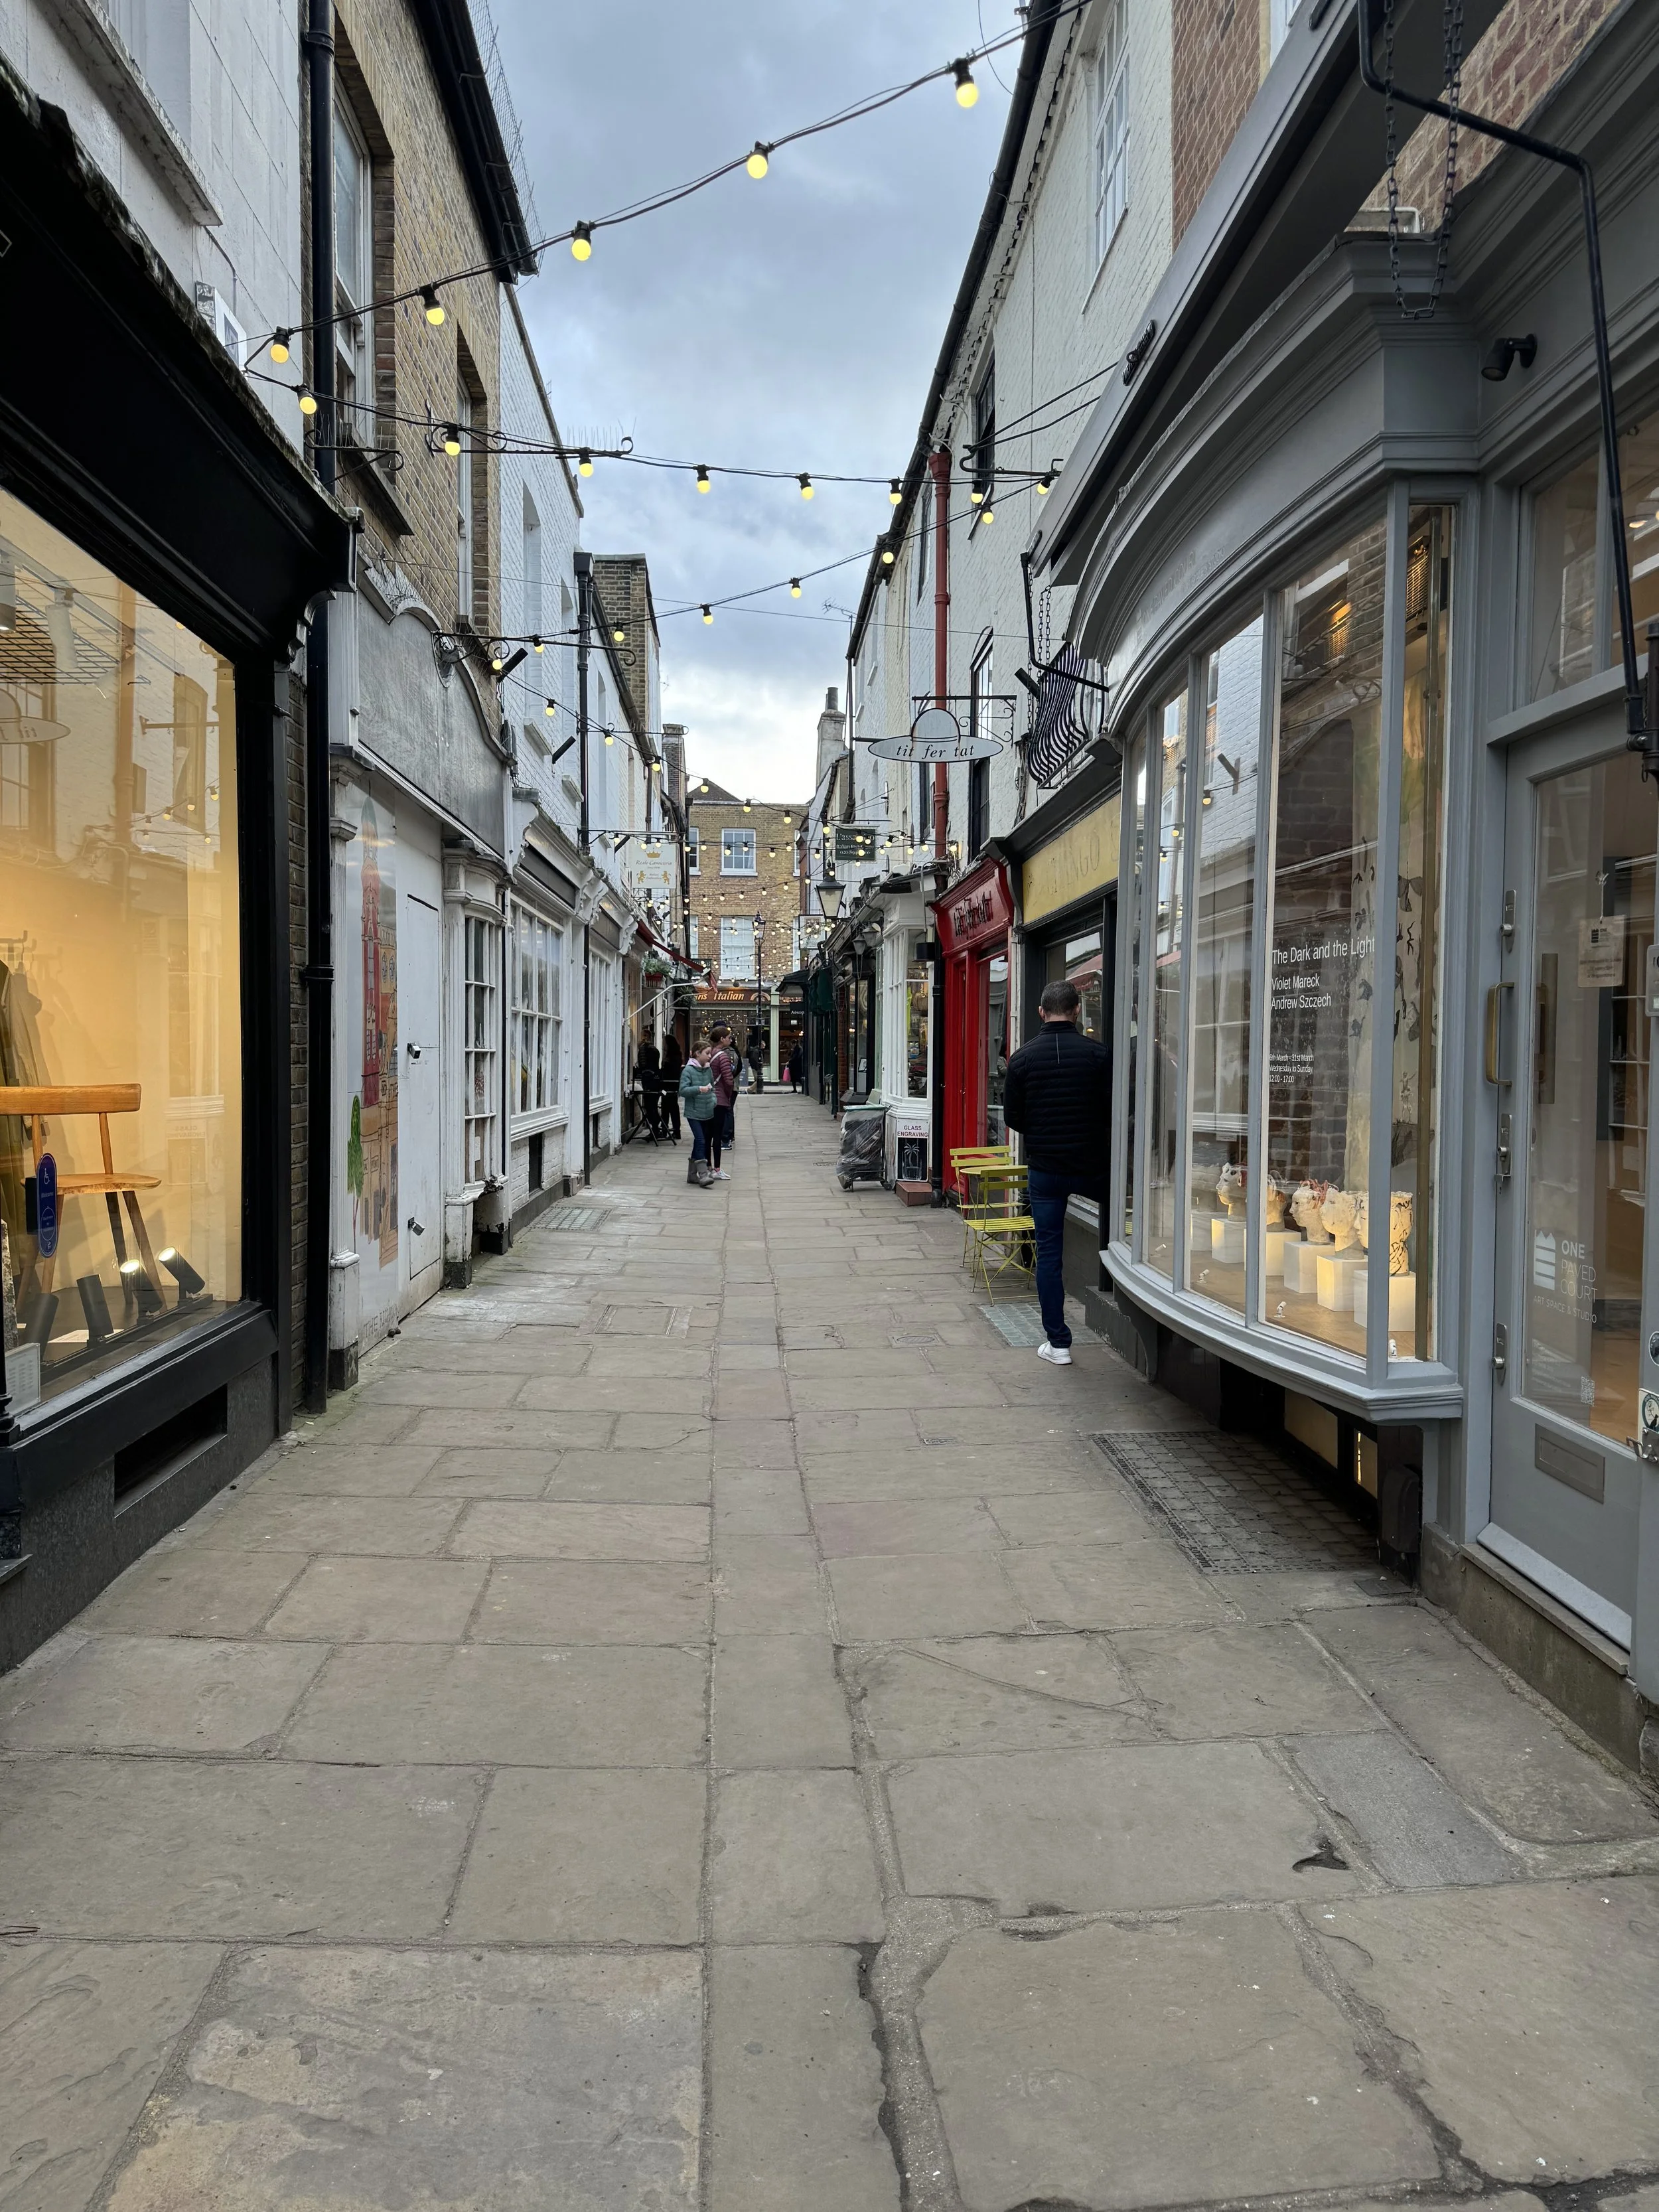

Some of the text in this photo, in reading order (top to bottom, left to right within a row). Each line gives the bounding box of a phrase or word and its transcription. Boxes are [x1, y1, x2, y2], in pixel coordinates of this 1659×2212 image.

[897, 744, 974, 759] tit fer tat
[1272, 936, 1375, 964] The Dark and the Light
[1271, 973, 1320, 991] Violet Mareck
[713, 991, 745, 1000] Italian
[1271, 993, 1331, 1010] Andrew Szczech
[1269, 1065, 1291, 1074] Wednesday
[1297, 1065, 1313, 1075] Sunday
[1561, 1240, 1585, 1260] ONE
[1561, 1259, 1596, 1282] PAVED
[1560, 1279, 1598, 1303] COURT
[1534, 1295, 1597, 1323] ART SPACE & STUDIO
